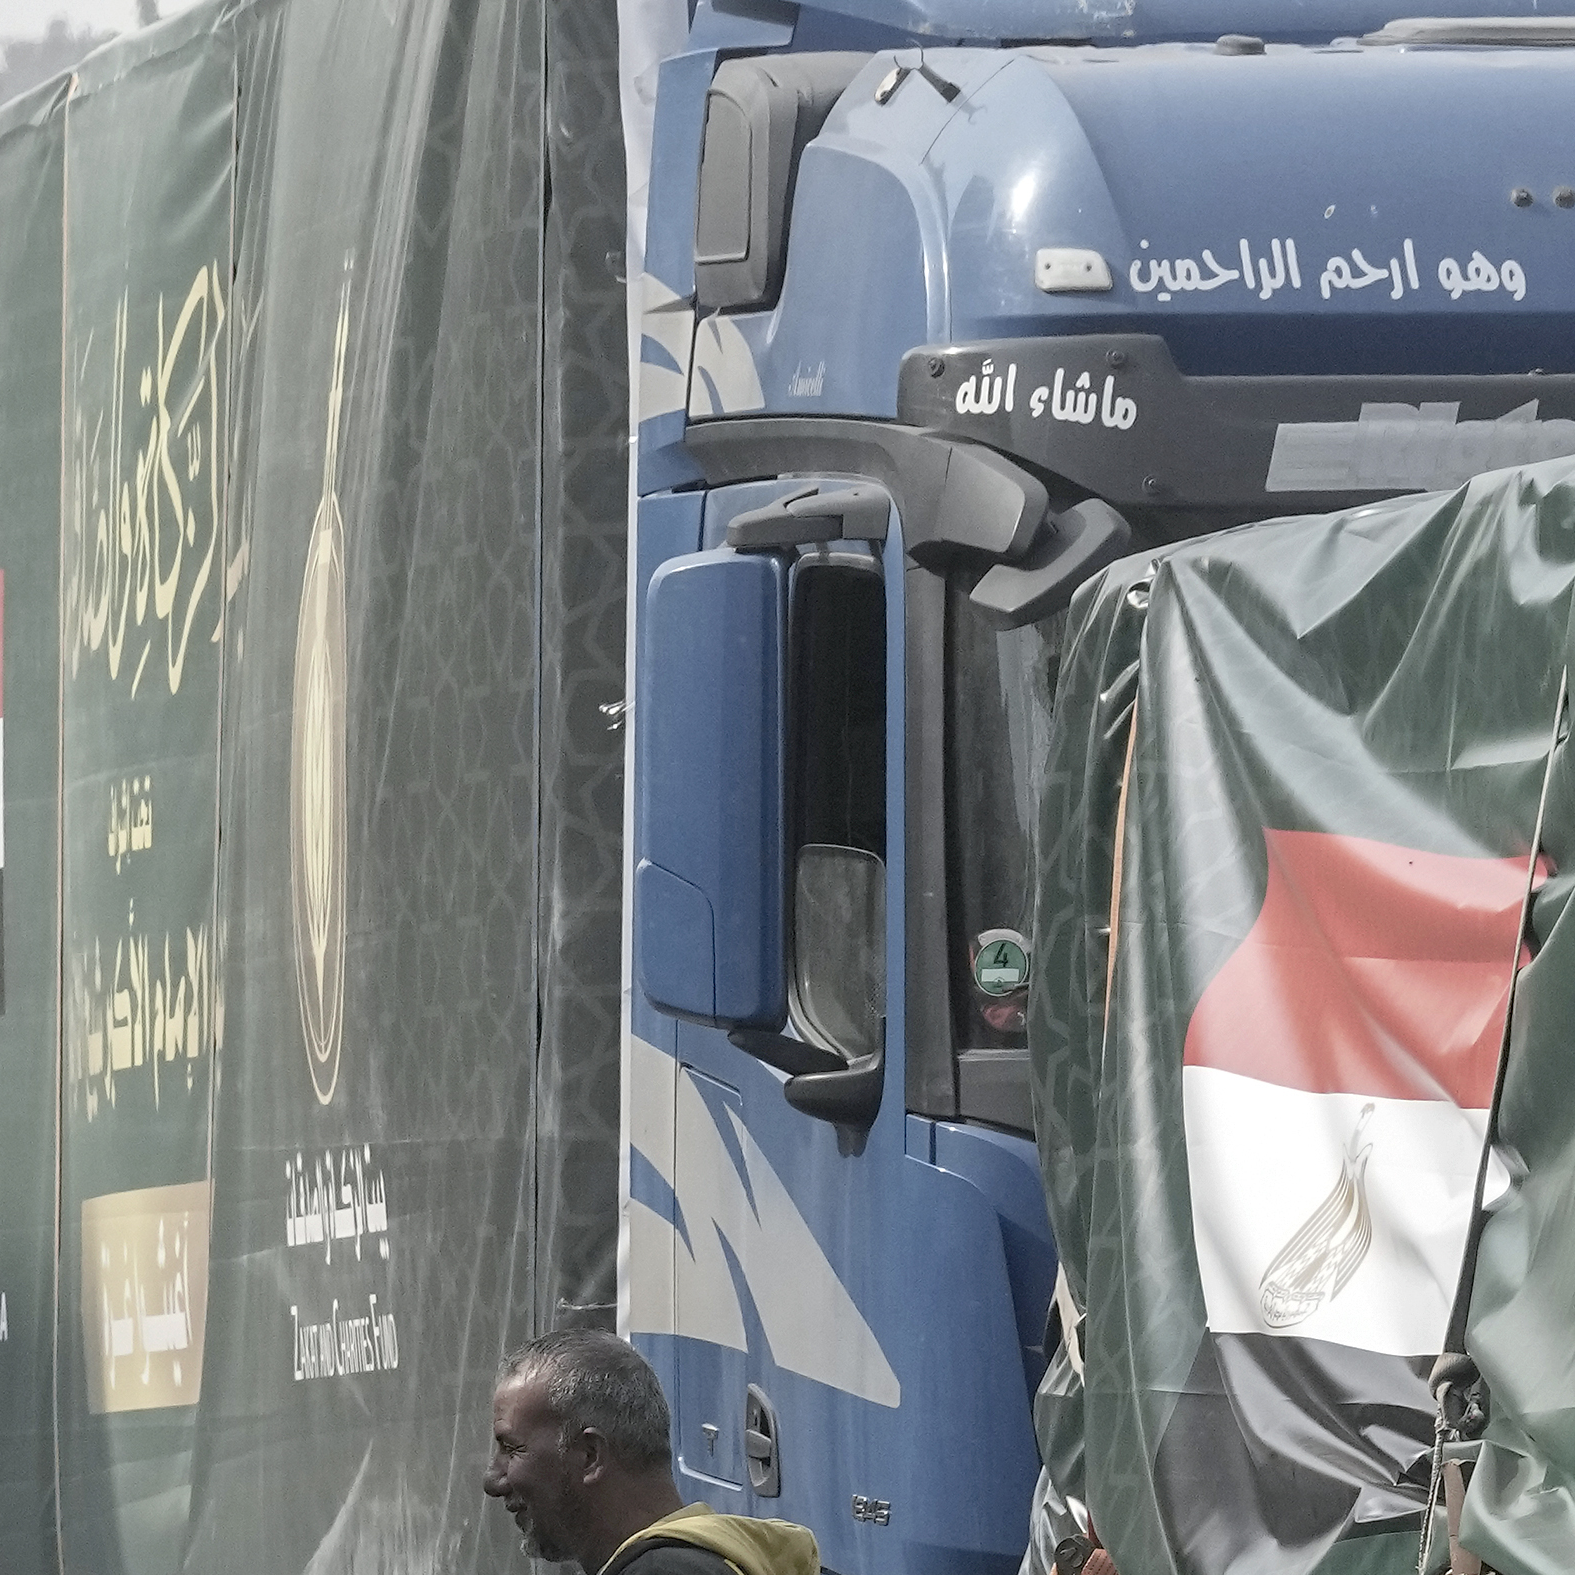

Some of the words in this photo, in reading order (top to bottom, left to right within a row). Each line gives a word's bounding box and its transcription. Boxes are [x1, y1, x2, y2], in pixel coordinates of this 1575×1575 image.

[1129, 237, 1302, 302] الراحمين
[1319, 237, 1420, 299] ارحم
[1436, 250, 1526, 301] وهو
[993, 942, 1009, 968] 4
[153, 922, 208, 1114] الإمام
[100, 1240, 134, 1391] غزة
[134, 1210, 194, 1388] أغيثوا
[290, 1304, 319, 1382] ZAKAT
[332, 1298, 375, 1377] CHARITIES
[369, 1293, 399, 1371] FUND
